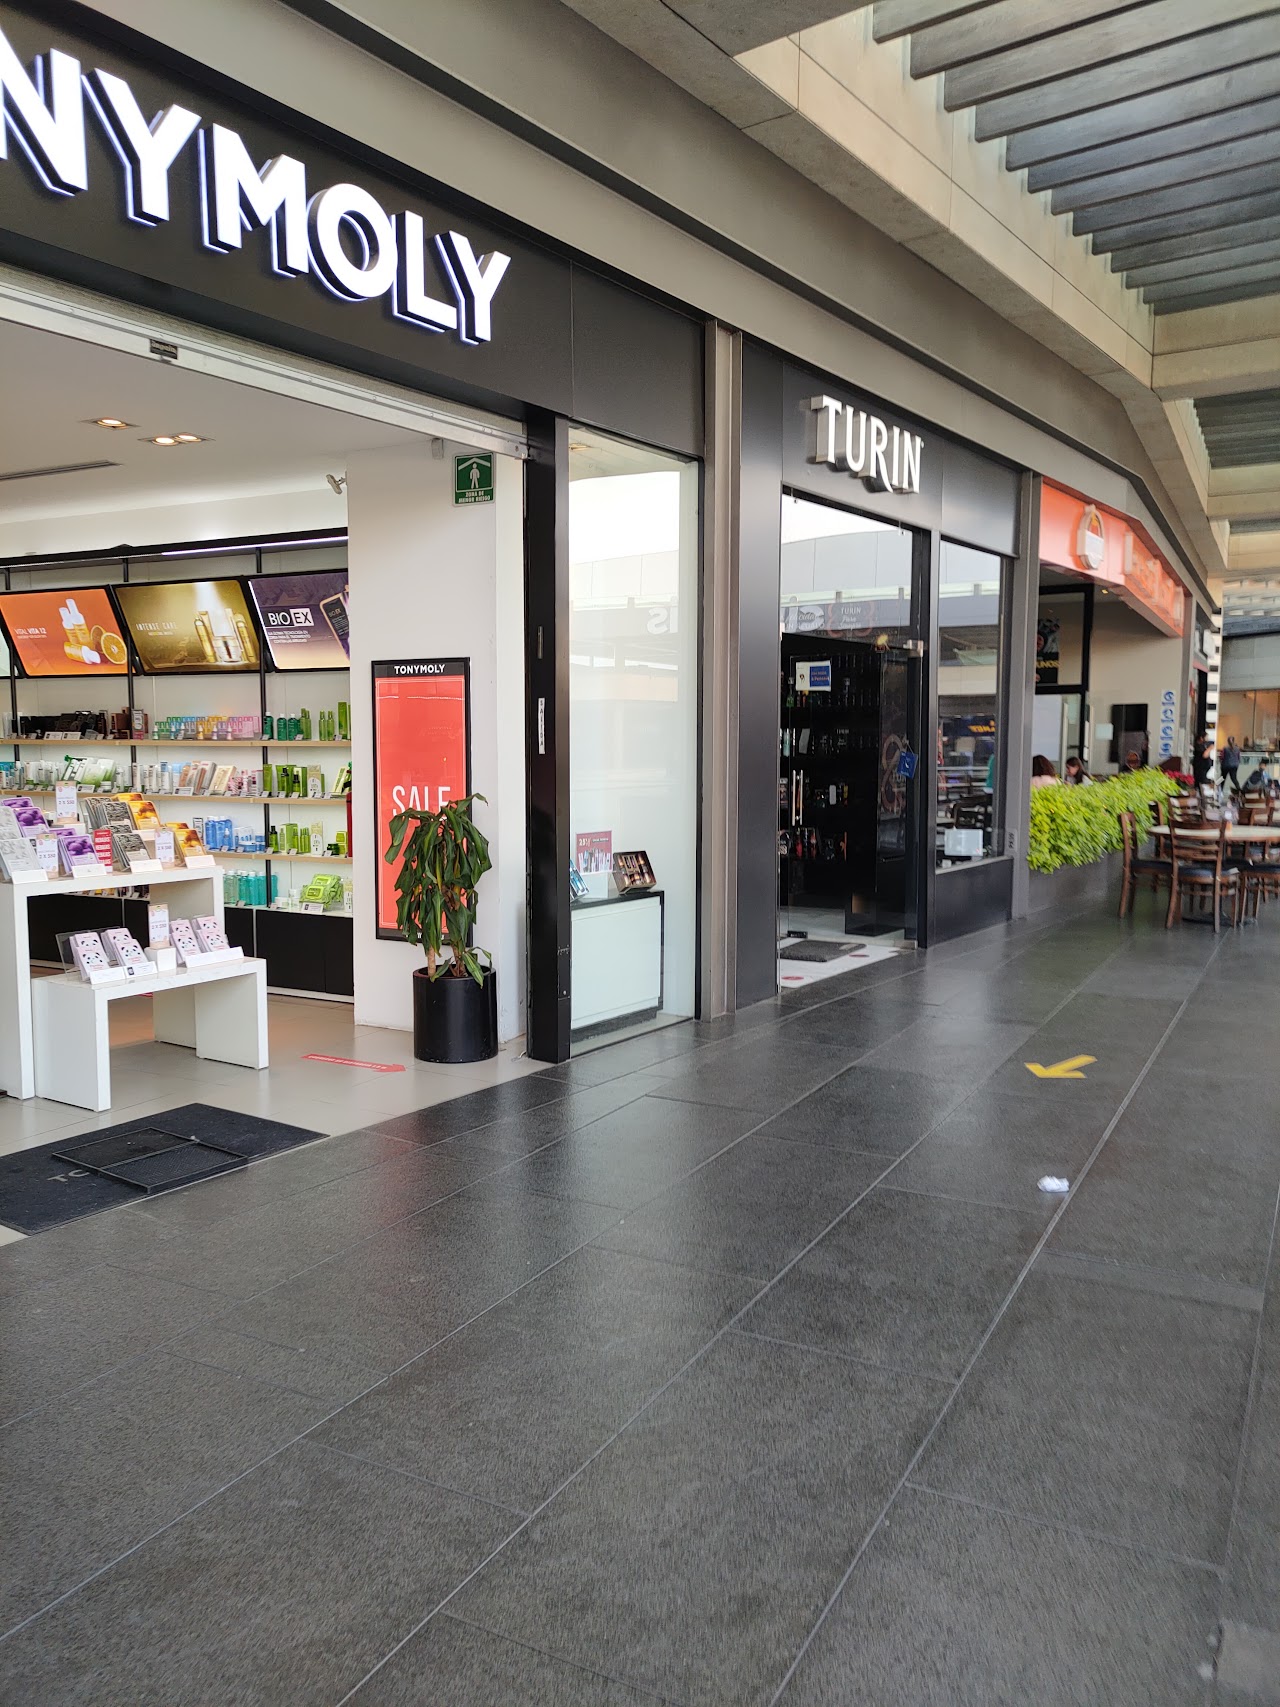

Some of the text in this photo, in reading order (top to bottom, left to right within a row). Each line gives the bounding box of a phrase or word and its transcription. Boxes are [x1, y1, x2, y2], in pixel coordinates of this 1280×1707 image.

[811, 394, 921, 494] TURIN
[268, 611, 312, 626] BIO EX
[136, 622, 160, 630] INTENSE
[394, 664, 446, 675] TONYMOLY
